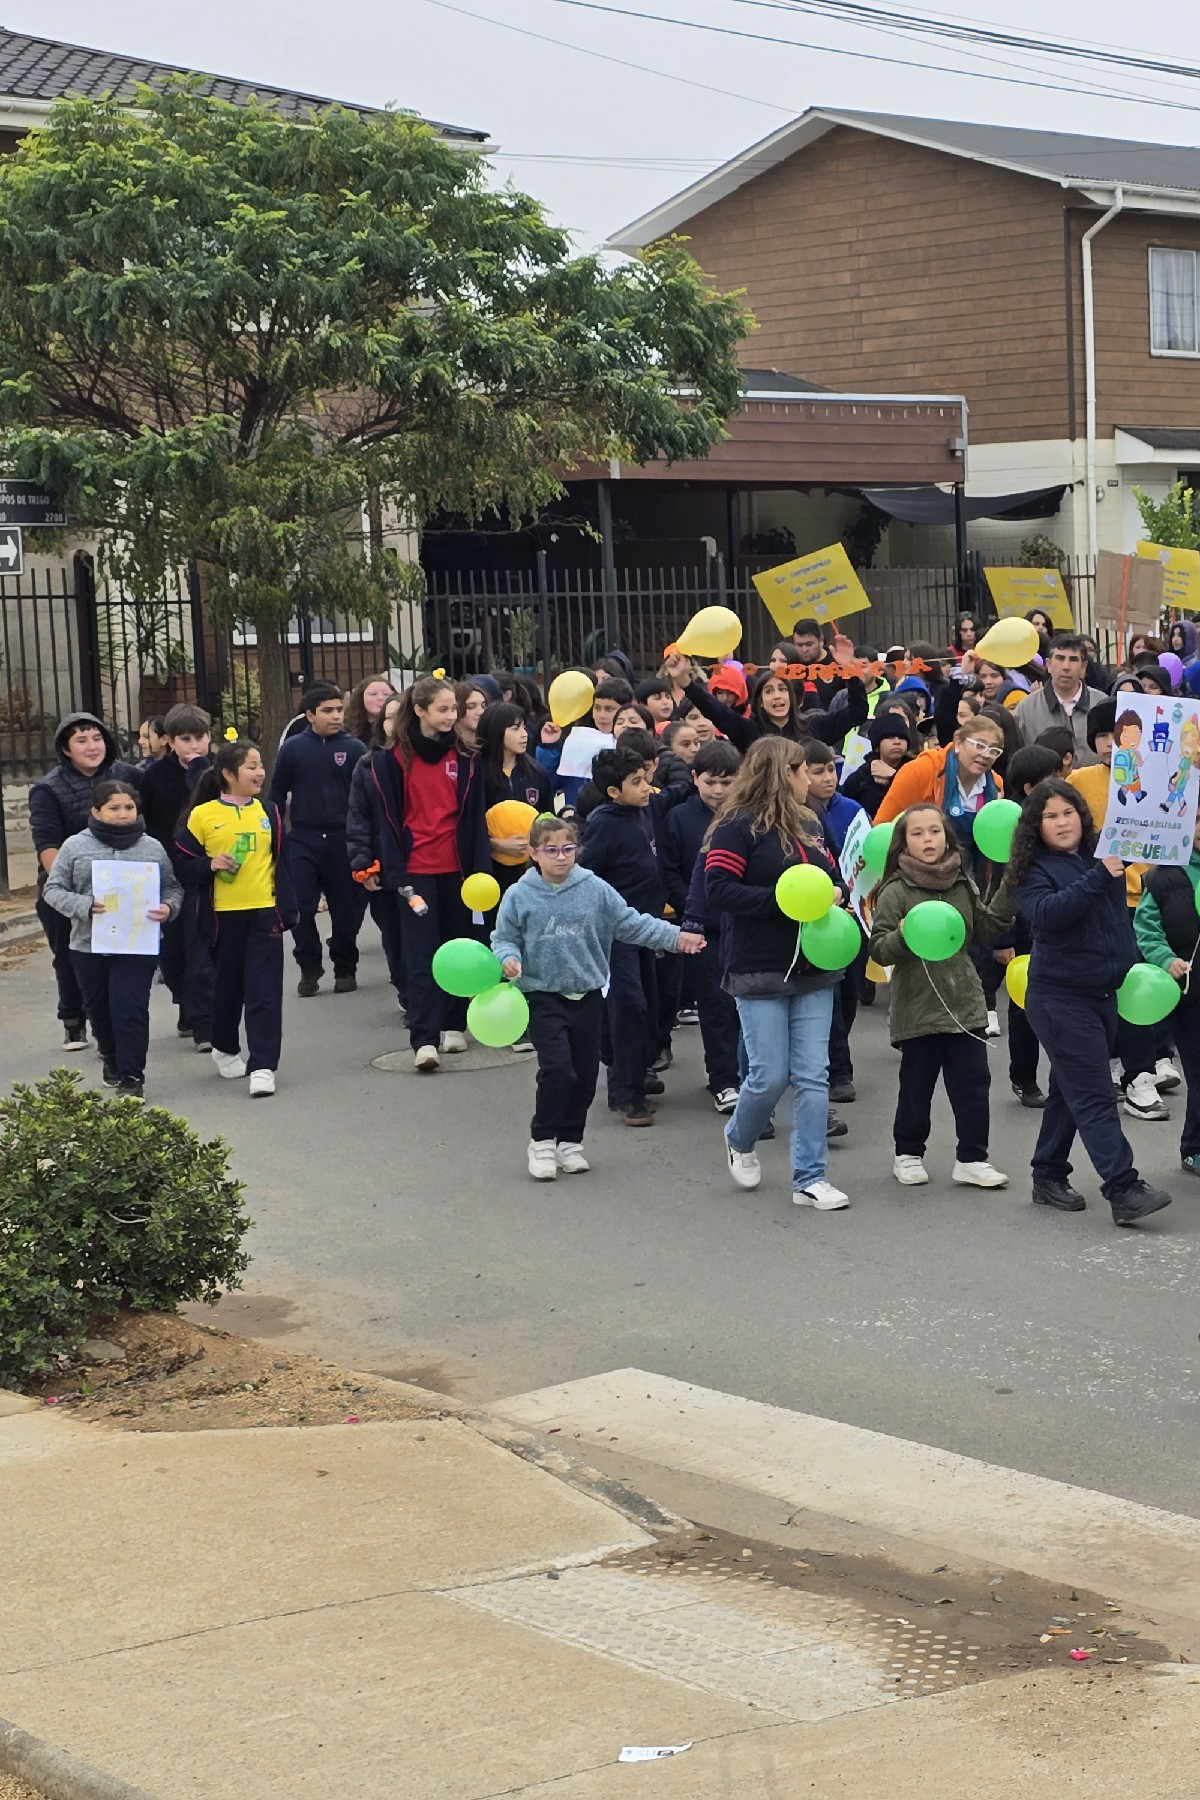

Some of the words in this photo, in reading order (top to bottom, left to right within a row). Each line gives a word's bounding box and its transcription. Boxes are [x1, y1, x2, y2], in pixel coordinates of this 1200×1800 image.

[16, 494, 26, 505] DE
[28, 495, 50, 505] TRIGO
[1121, 829, 1138, 839] CON
[1150, 833, 1161, 841] MI
[1108, 839, 1179, 860] ESCUELA
